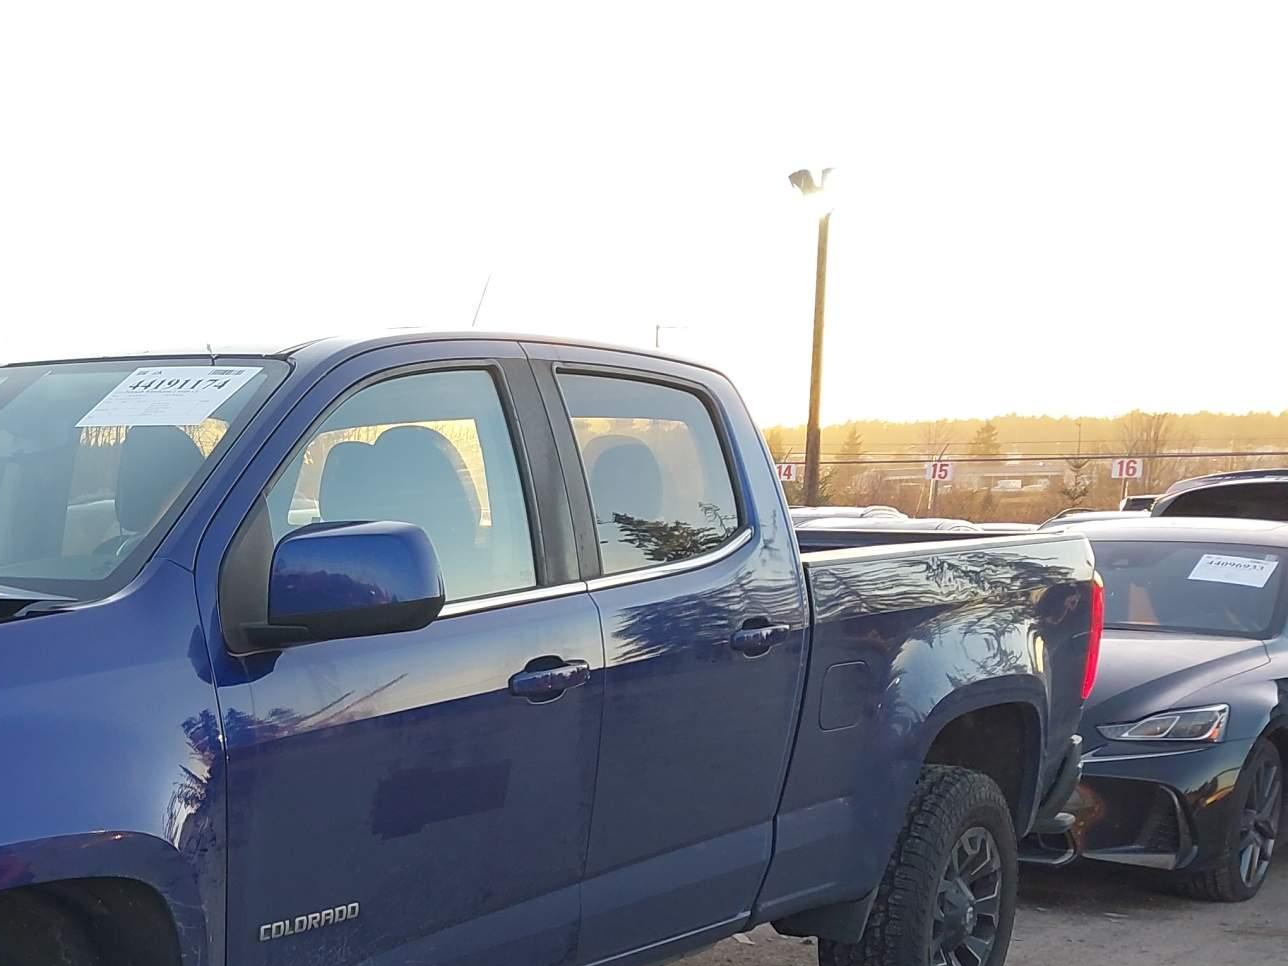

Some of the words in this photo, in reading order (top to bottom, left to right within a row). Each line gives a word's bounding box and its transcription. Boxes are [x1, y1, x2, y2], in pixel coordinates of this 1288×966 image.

[128, 378, 231, 391] 44191174
[777, 464, 793, 480] 14
[931, 463, 950, 480] 15
[1117, 460, 1138, 477] 16
[259, 902, 360, 942] COLORADO
